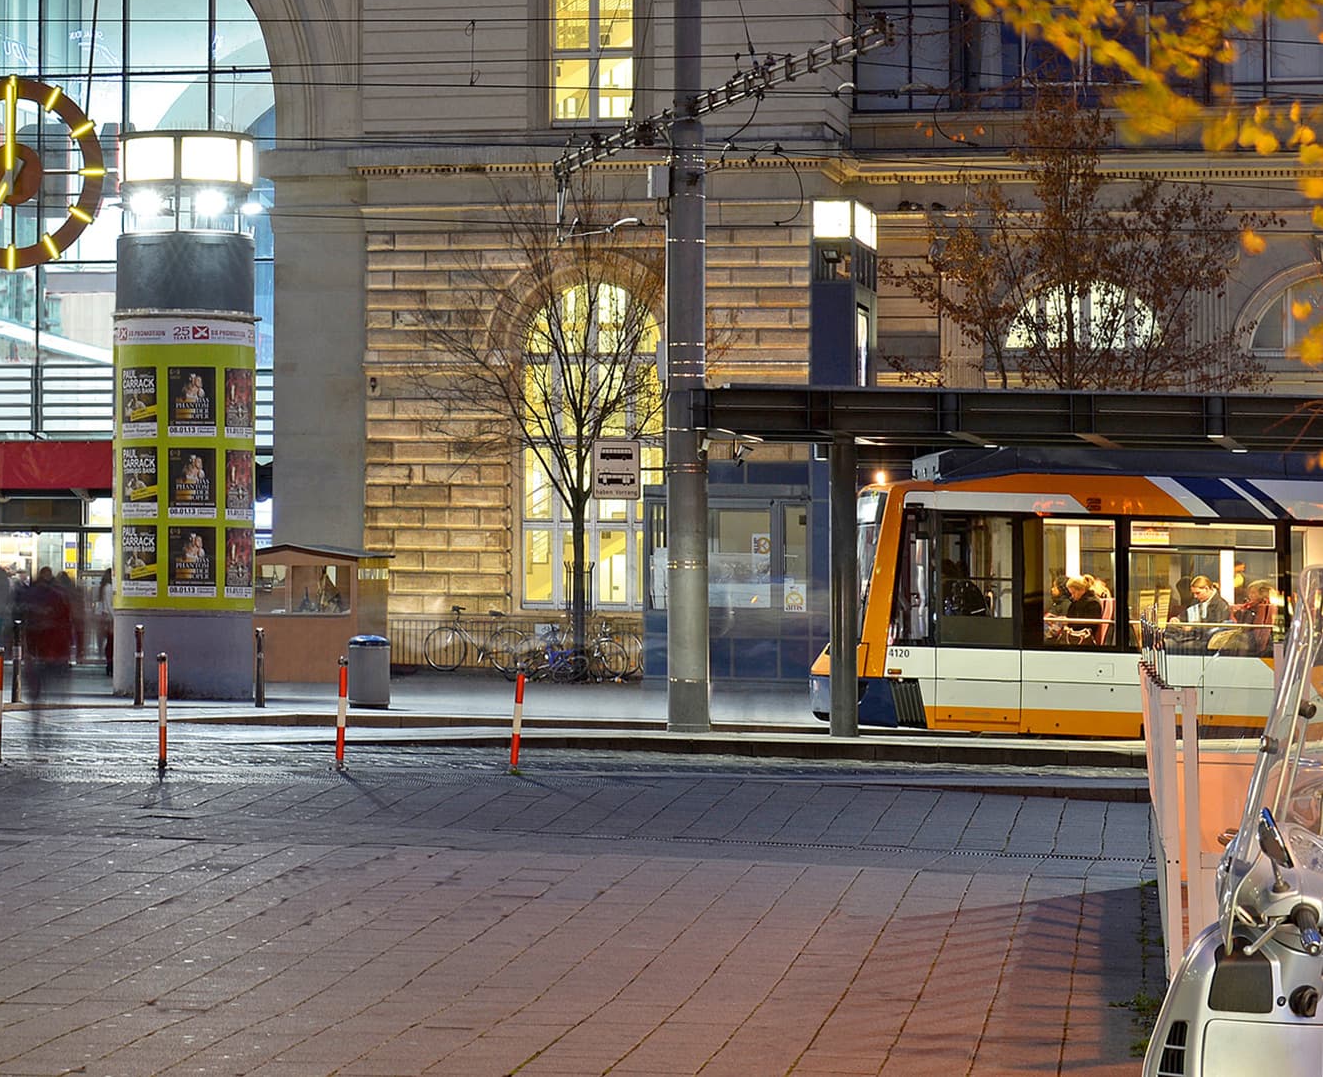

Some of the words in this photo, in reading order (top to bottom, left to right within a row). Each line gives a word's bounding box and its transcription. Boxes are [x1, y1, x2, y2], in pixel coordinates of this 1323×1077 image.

[173, 326, 190, 336] 25
[123, 370, 137, 379] PAUL
[123, 378, 155, 389] CARRACK
[123, 449, 137, 458] PAUL
[123, 458, 155, 468] CARRACK
[123, 526, 137, 536] PAUL
[123, 536, 155, 546] CARRACK
[888, 649, 910, 658] 4120
